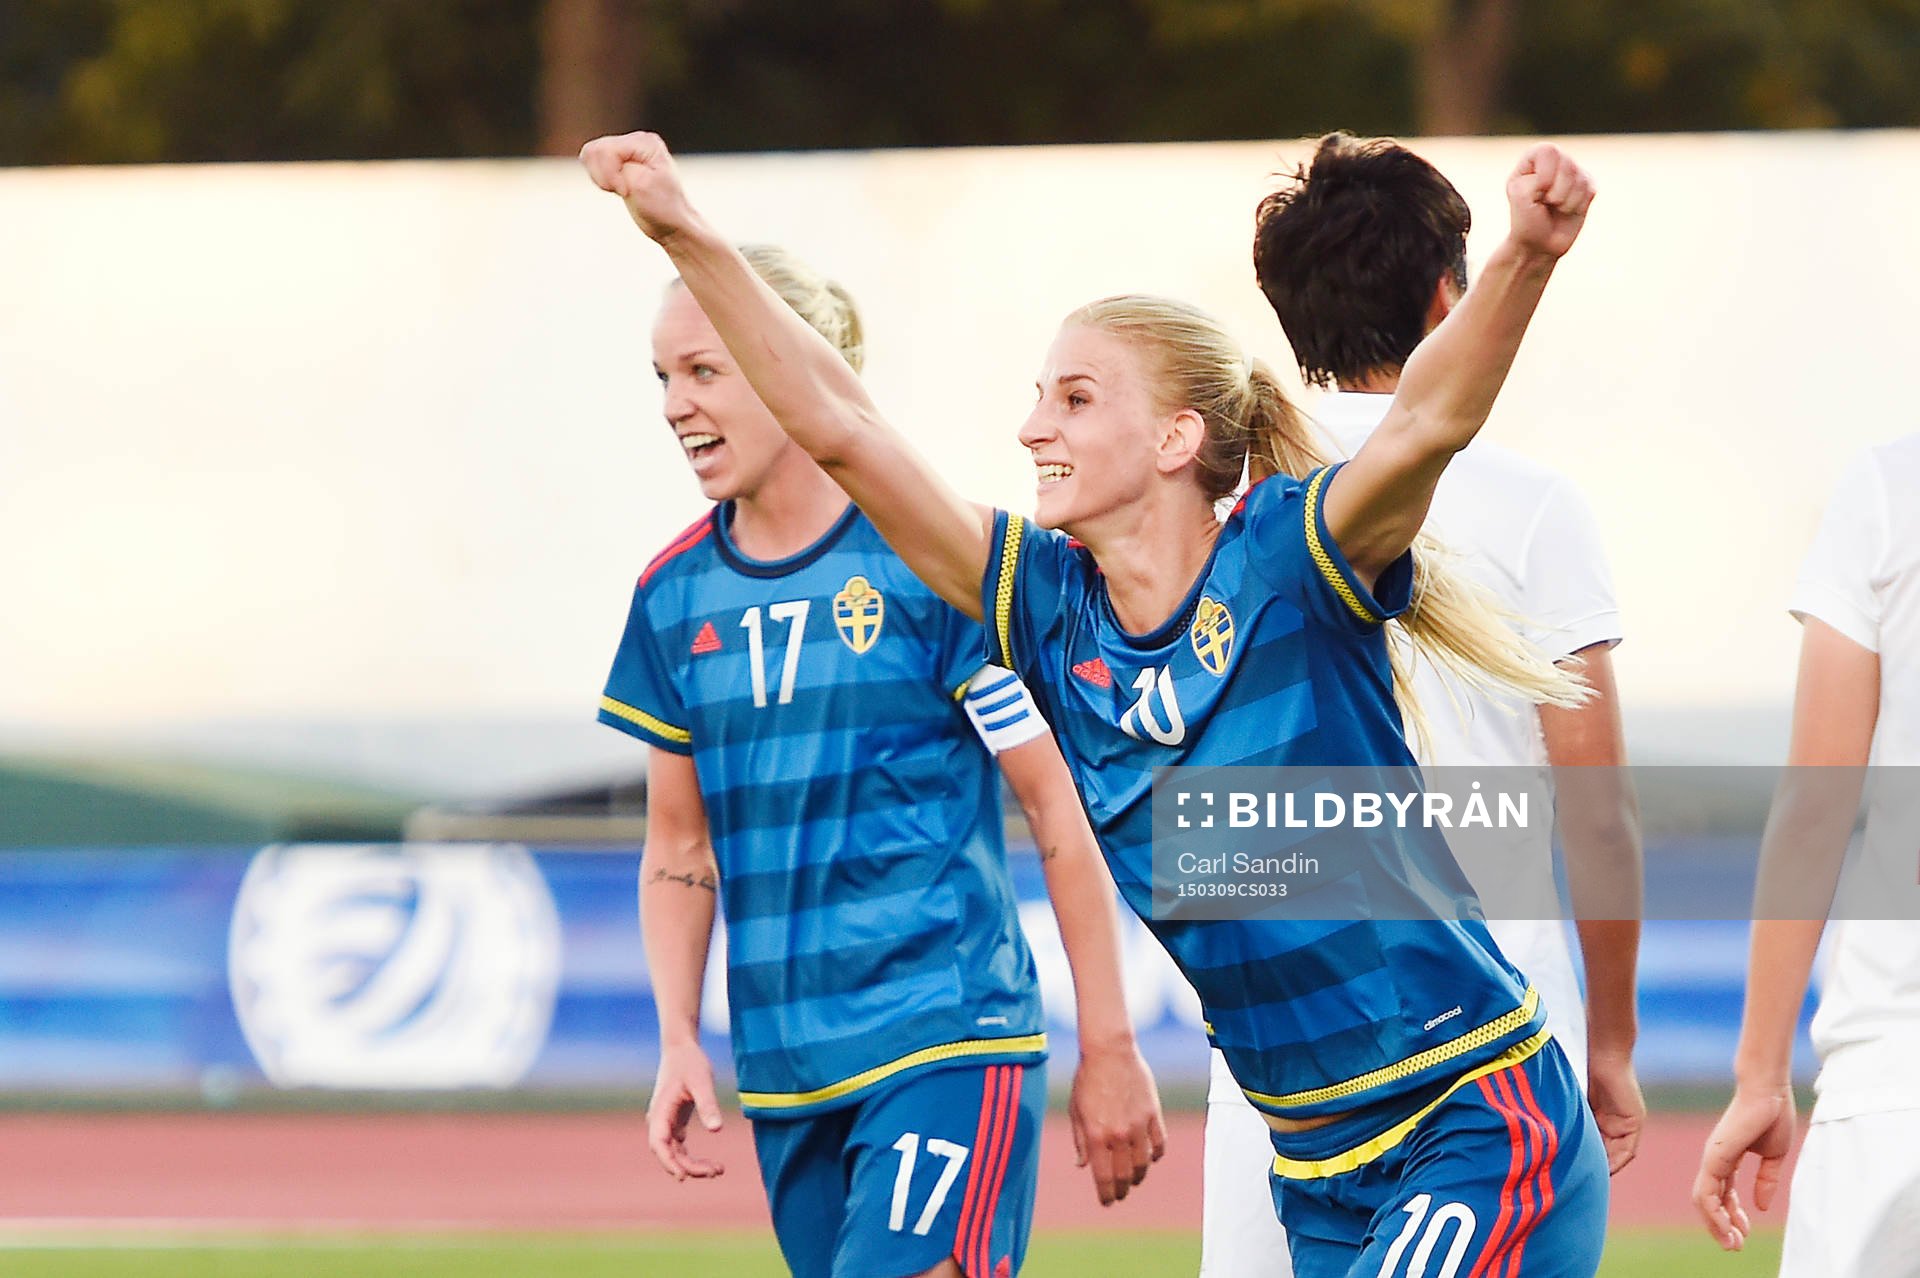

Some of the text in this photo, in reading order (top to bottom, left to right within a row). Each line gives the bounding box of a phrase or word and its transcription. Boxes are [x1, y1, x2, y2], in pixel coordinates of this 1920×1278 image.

[740, 600, 811, 708] 17
[1120, 664, 1185, 746] 10
[889, 1132, 969, 1236] 17
[1376, 1193, 1477, 1278] 10
